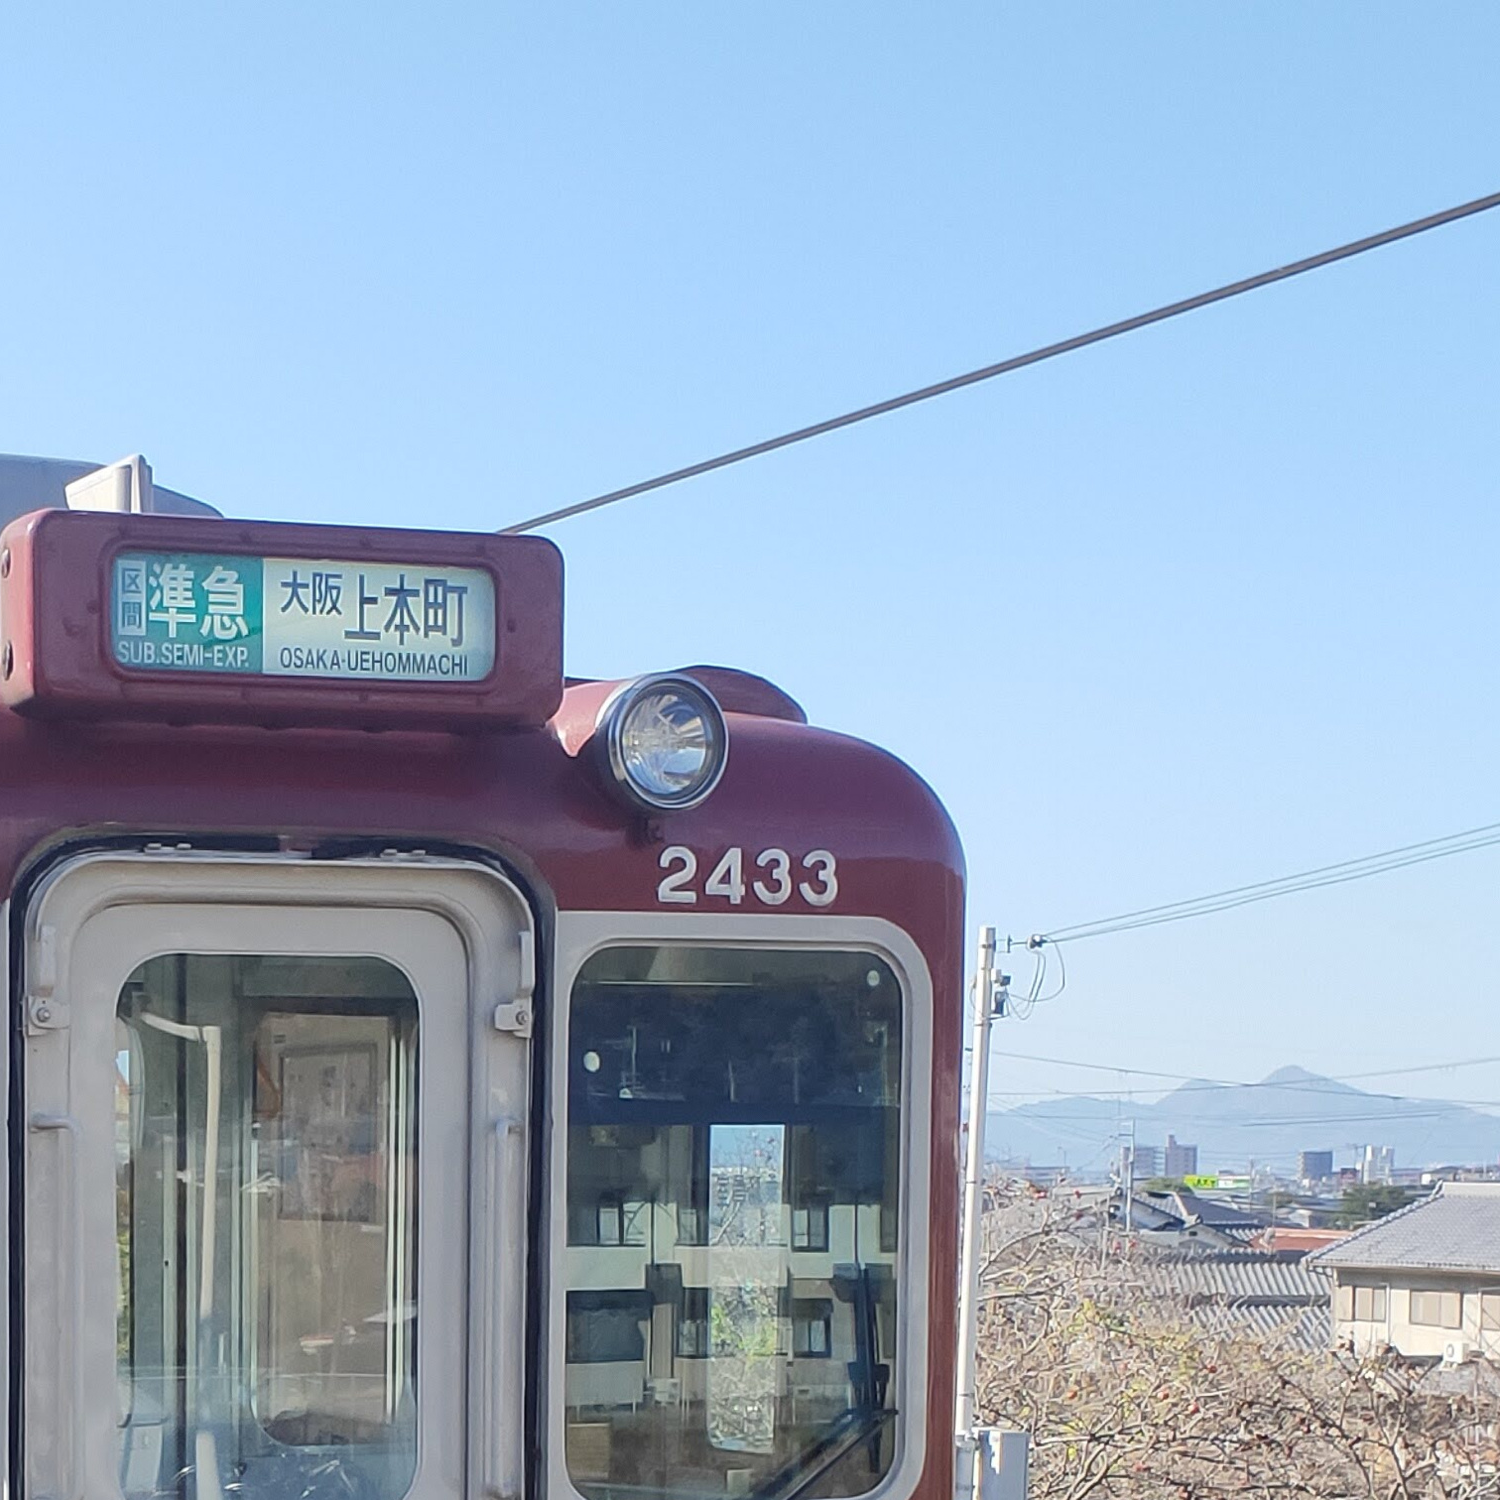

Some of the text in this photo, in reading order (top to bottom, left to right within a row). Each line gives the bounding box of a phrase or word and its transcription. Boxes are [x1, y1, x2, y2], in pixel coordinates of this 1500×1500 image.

[122, 567, 142, 629] 区間
[149, 563, 249, 640] 準急
[280, 570, 468, 648] 大阪上本町
[116, 640, 249, 668] SUB.SEMI-EXP.
[280, 647, 468, 676] OSAKA-UEHOMMACHI
[658, 845, 839, 906] 2433
